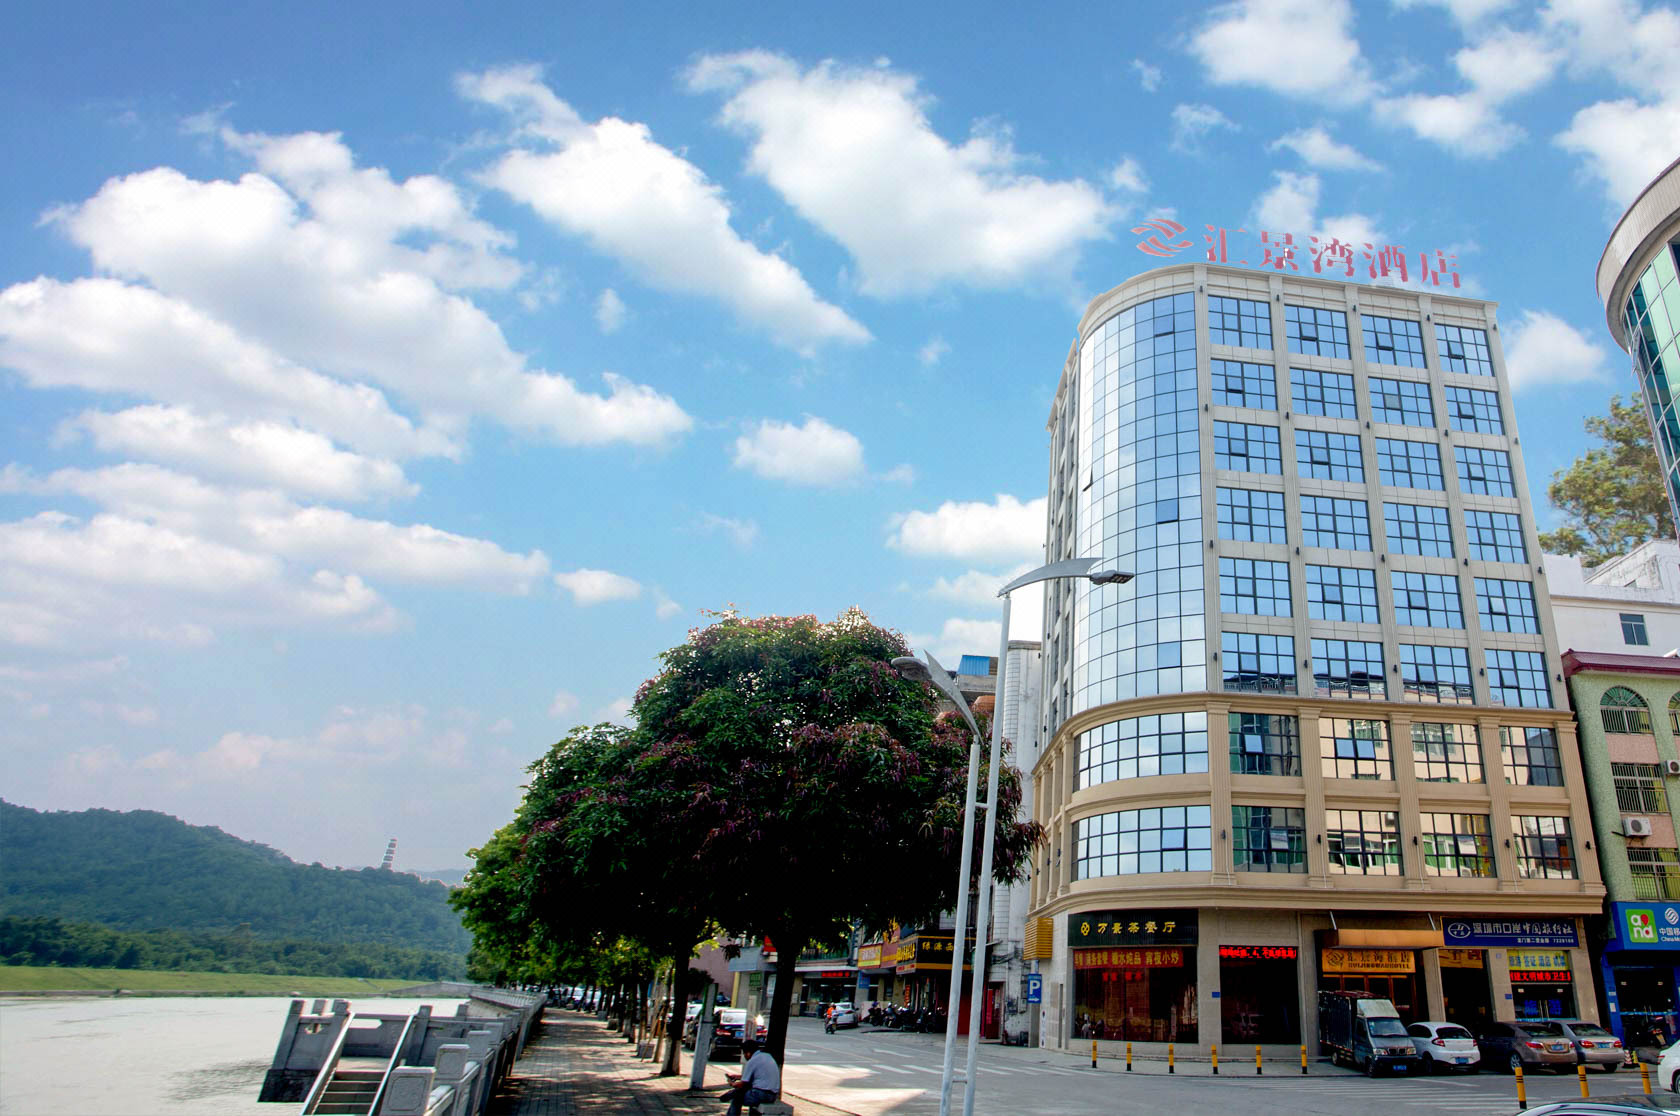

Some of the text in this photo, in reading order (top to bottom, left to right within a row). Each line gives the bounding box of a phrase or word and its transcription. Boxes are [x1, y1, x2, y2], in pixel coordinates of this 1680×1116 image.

[1204, 224, 1461, 289] 汇景湾酒店
[1472, 922, 1574, 935] 深圳市口岸中国旅行社
[1029, 979, 1041, 995] P
